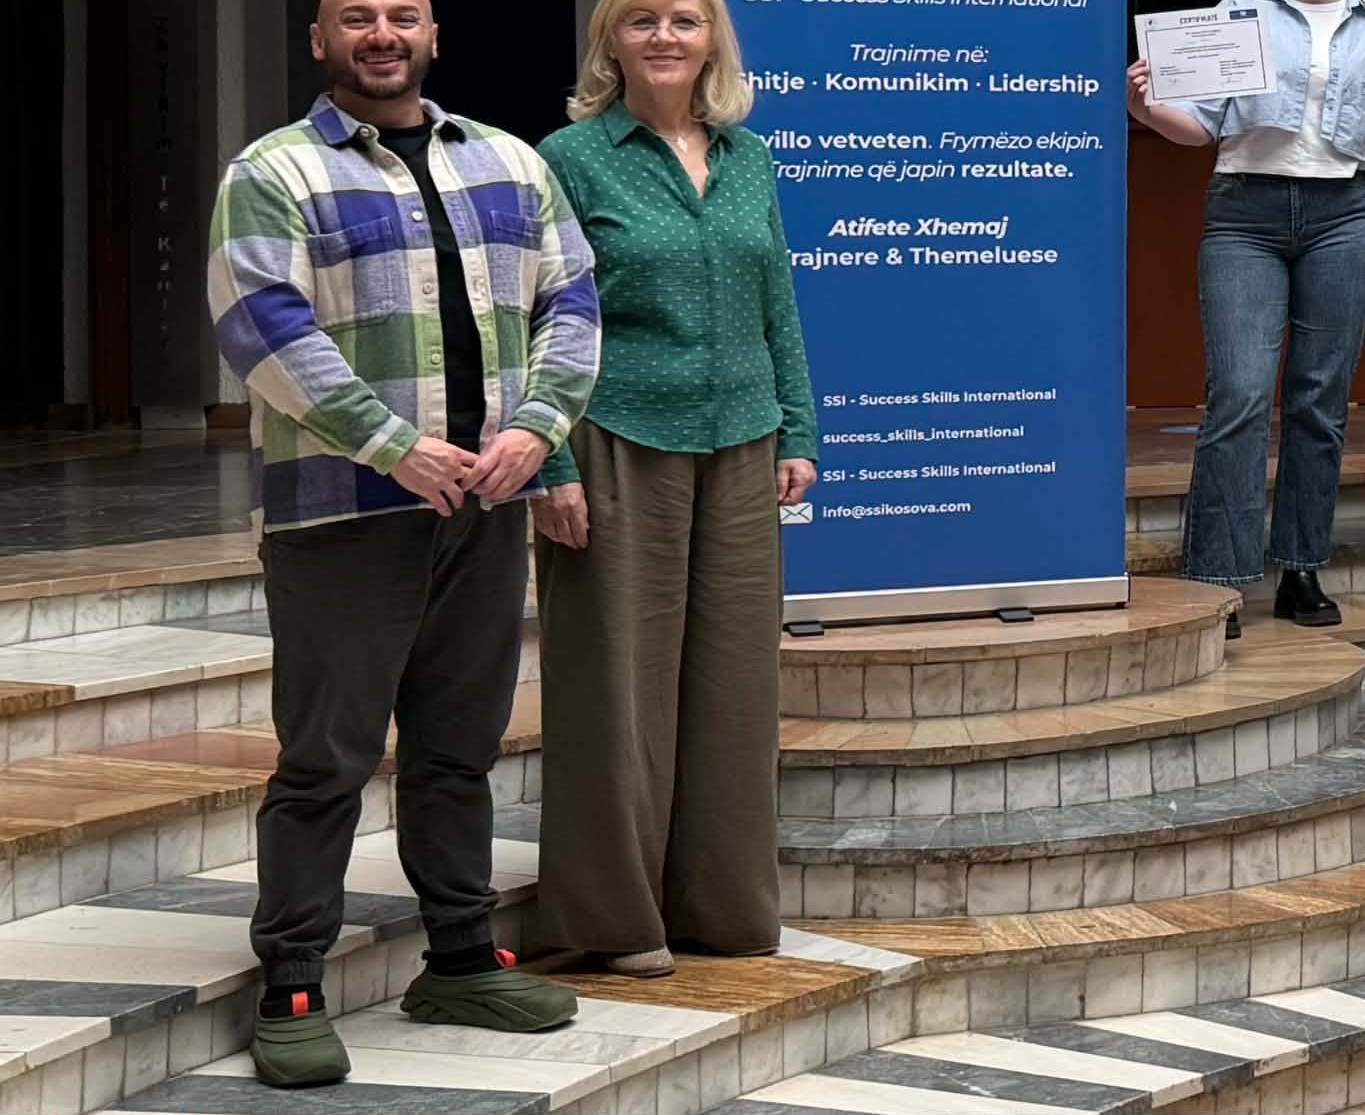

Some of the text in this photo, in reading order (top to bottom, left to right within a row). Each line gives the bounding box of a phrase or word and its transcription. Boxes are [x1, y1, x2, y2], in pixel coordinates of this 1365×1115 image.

[850, 42, 989, 65] Trajnime në:
[826, 72, 969, 93] Komunikim
[988, 74, 1100, 96] Lidership
[759, 130, 1104, 154] villo vetveten. Frymëzo ekipin.
[868, 160, 897, 183] që
[895, 159, 956, 182] japin
[961, 160, 1074, 178] rezultate.
[828, 216, 1009, 239] Atifete Xhemaj
[786, 246, 1058, 270] rajnere & Themeluese
[823, 394, 846, 407] SSI
[859, 393, 918, 406] Success
[922, 390, 961, 405] Skills
[963, 388, 1057, 403] International
[823, 424, 1025, 444] success_skills_international
[823, 469, 846, 482] SSI
[858, 468, 918, 481] Success
[921, 465, 960, 479] Skills
[963, 461, 1057, 477] International
[823, 501, 972, 520] info@ssikosova.com
